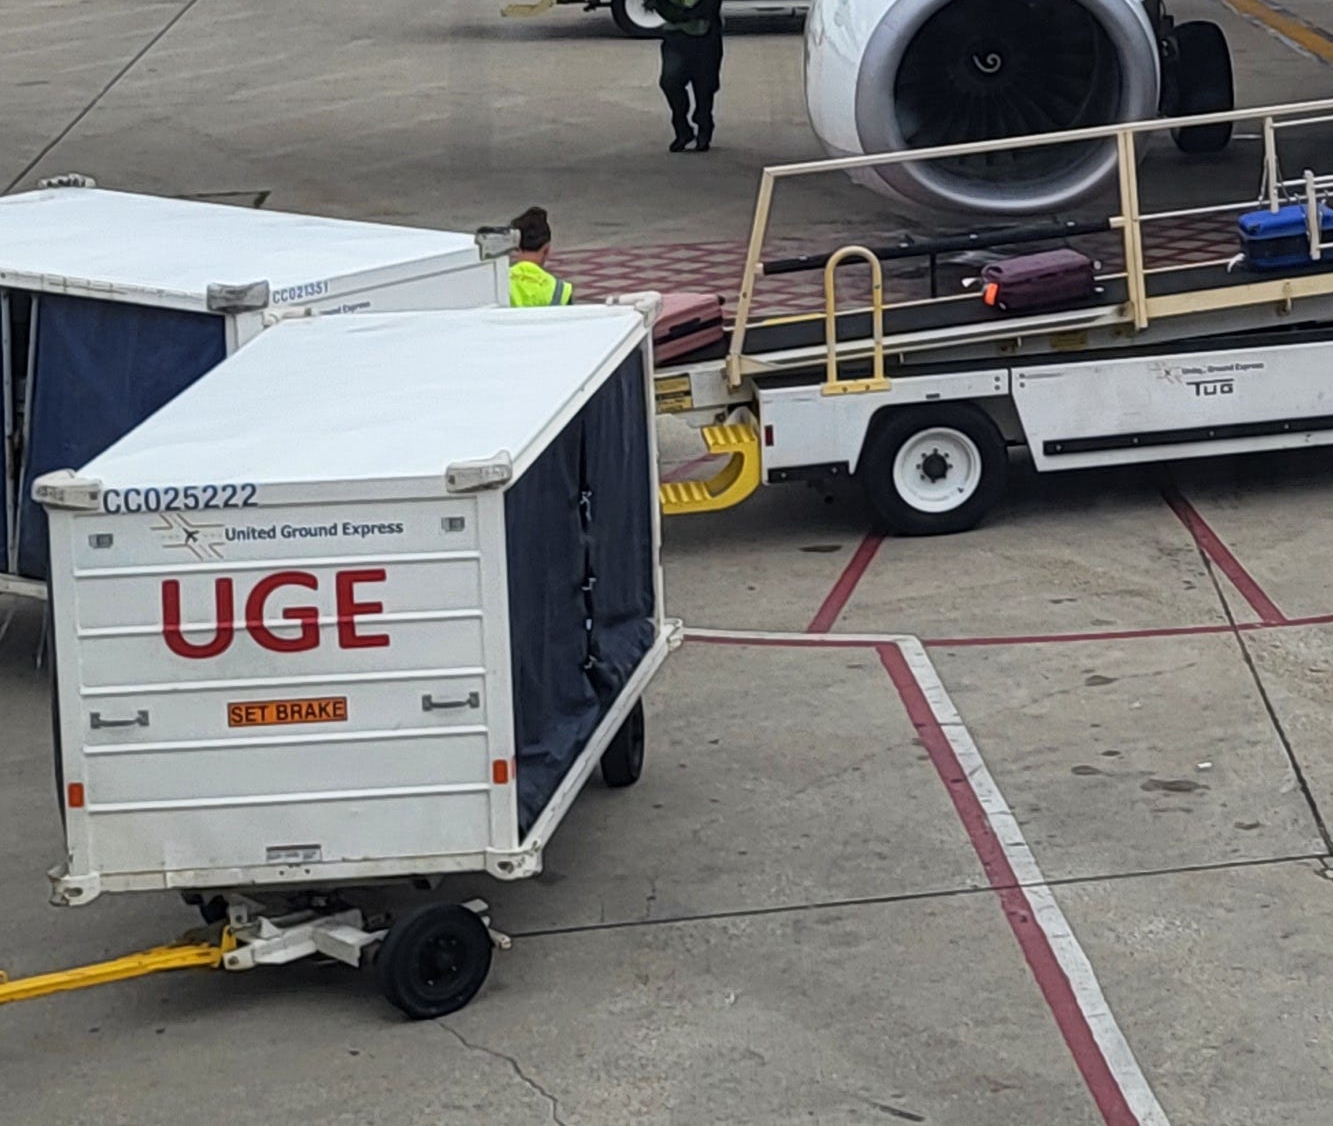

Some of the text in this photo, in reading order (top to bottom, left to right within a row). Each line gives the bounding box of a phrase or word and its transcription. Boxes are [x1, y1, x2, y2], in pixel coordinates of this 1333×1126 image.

[103, 483, 259, 515] CC025222
[224, 522, 404, 542] United Ground Express
[161, 568, 390, 660] UGE
[230, 700, 345, 723] SET BRAKE
